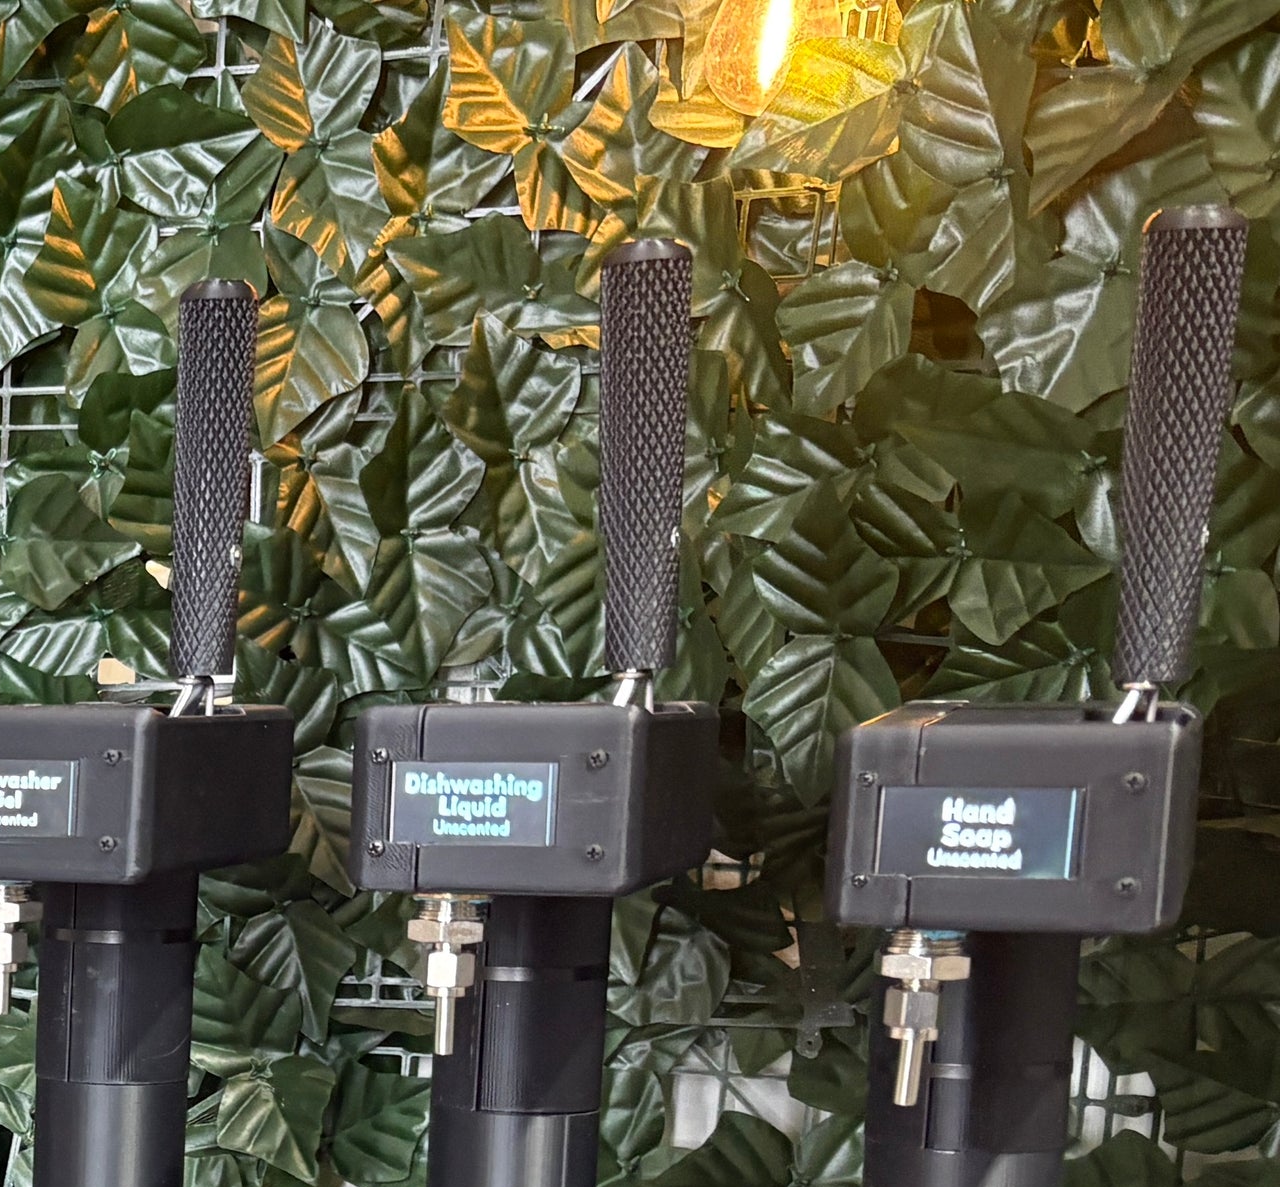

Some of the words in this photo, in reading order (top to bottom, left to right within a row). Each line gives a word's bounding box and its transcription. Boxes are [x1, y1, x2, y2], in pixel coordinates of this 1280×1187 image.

[405, 772, 543, 801] Dishwashing
[438, 795, 506, 821] Liquid
[942, 796, 1016, 825] Hand
[433, 819, 510, 837] Unscented
[940, 822, 1012, 852] Soap
